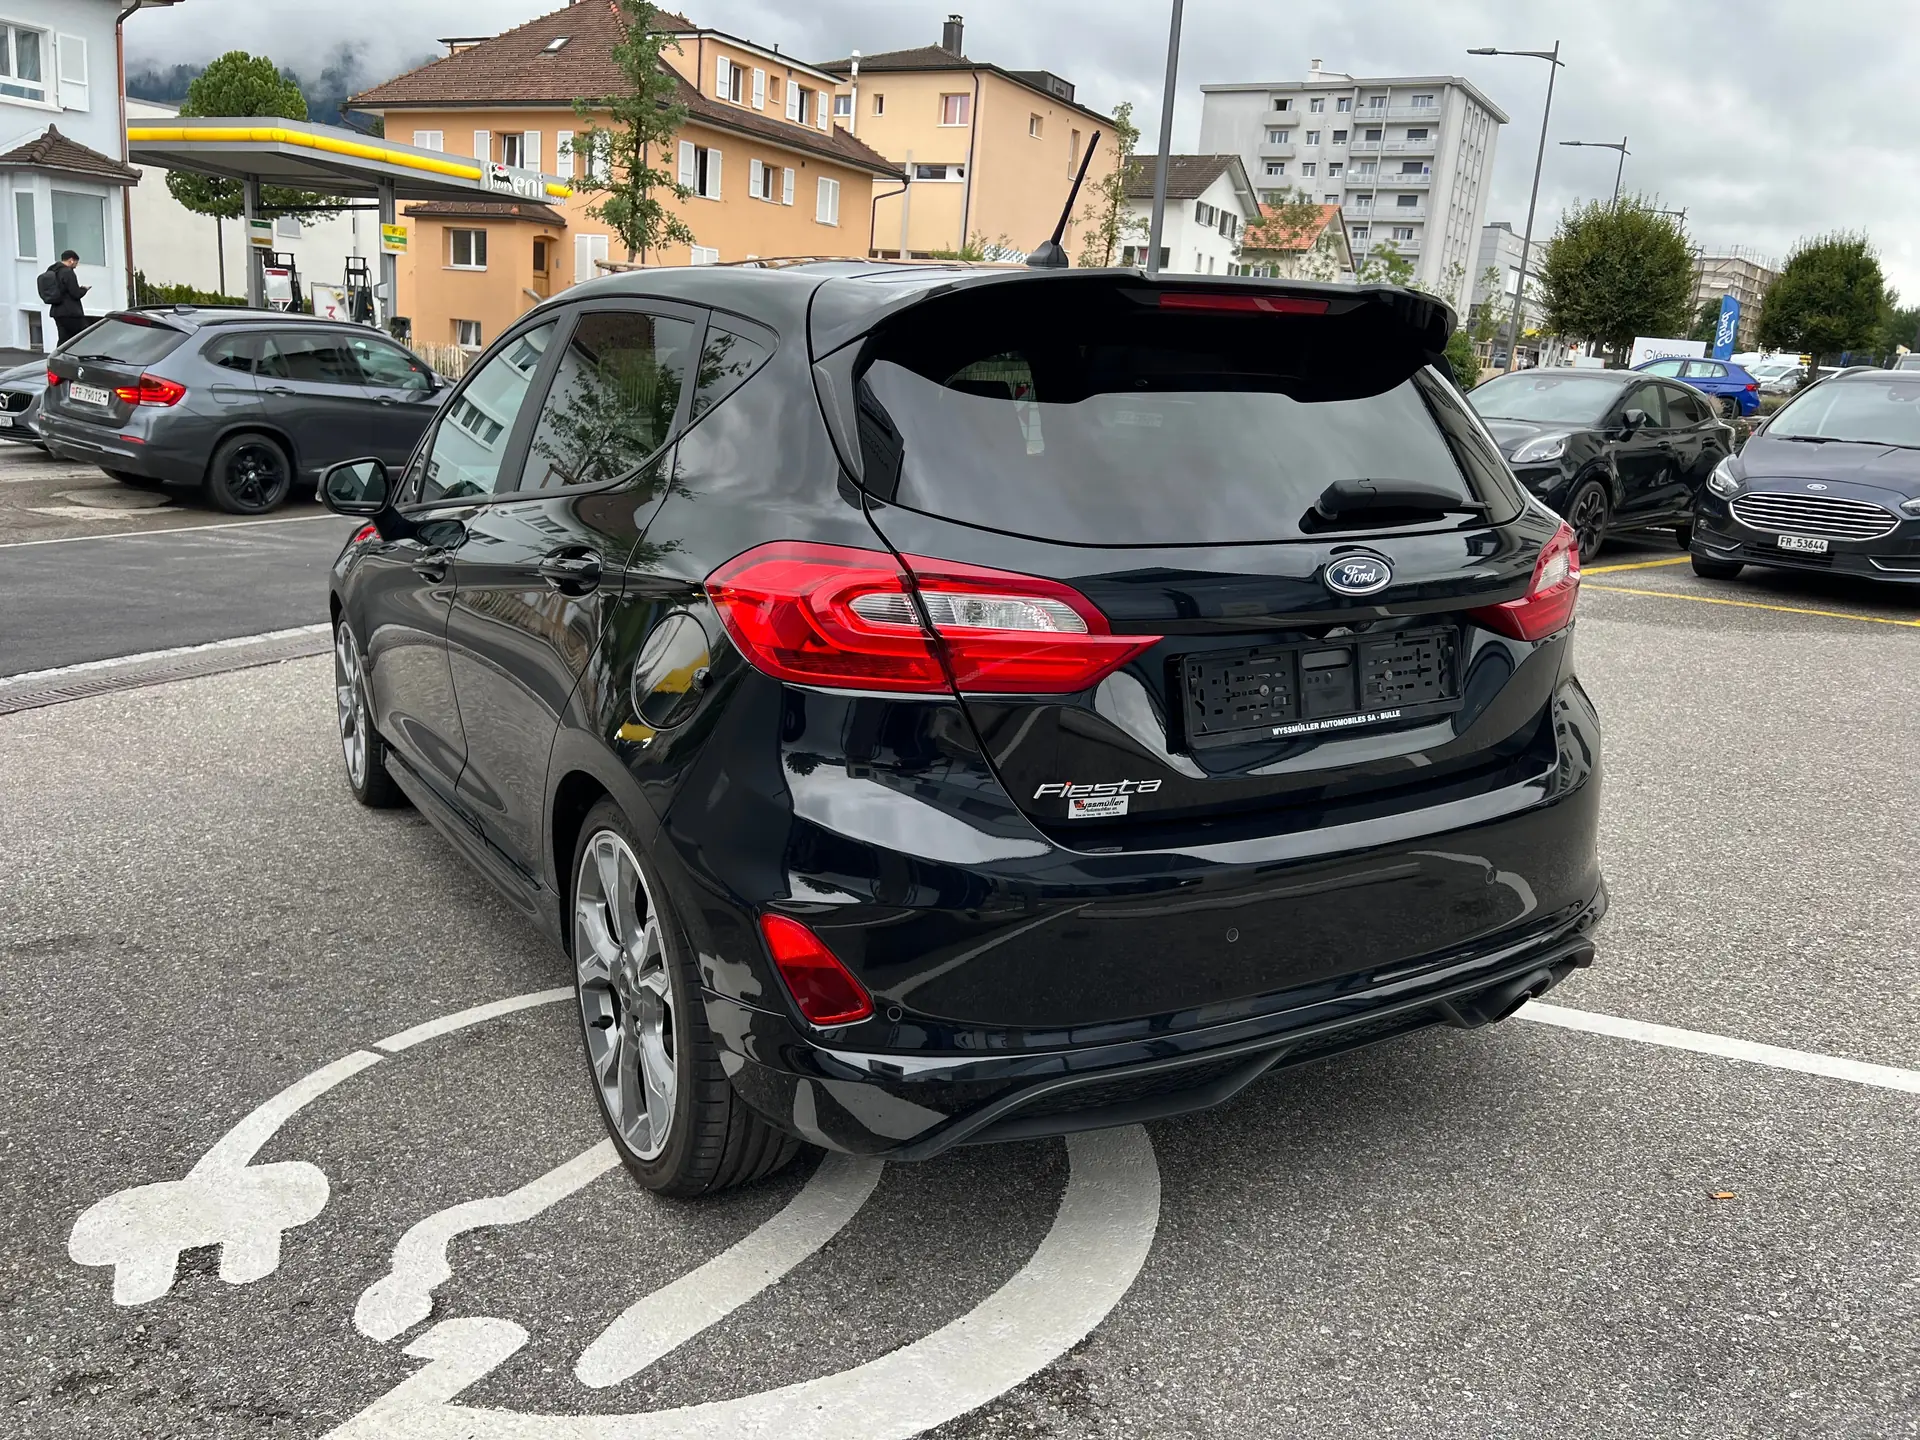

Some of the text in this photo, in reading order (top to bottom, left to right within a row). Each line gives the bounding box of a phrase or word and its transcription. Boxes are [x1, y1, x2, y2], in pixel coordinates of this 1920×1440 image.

[513, 174, 543, 199] eni
[1717, 311, 1736, 347] Ford
[1341, 564, 1377, 585] Ford
[1272, 723, 1320, 736] WYSSMÜLLER
[1320, 715, 1367, 729] AUTOMOBILES
[1380, 710, 1401, 720] BULLE
[1033, 779, 1162, 800] Fiesta
